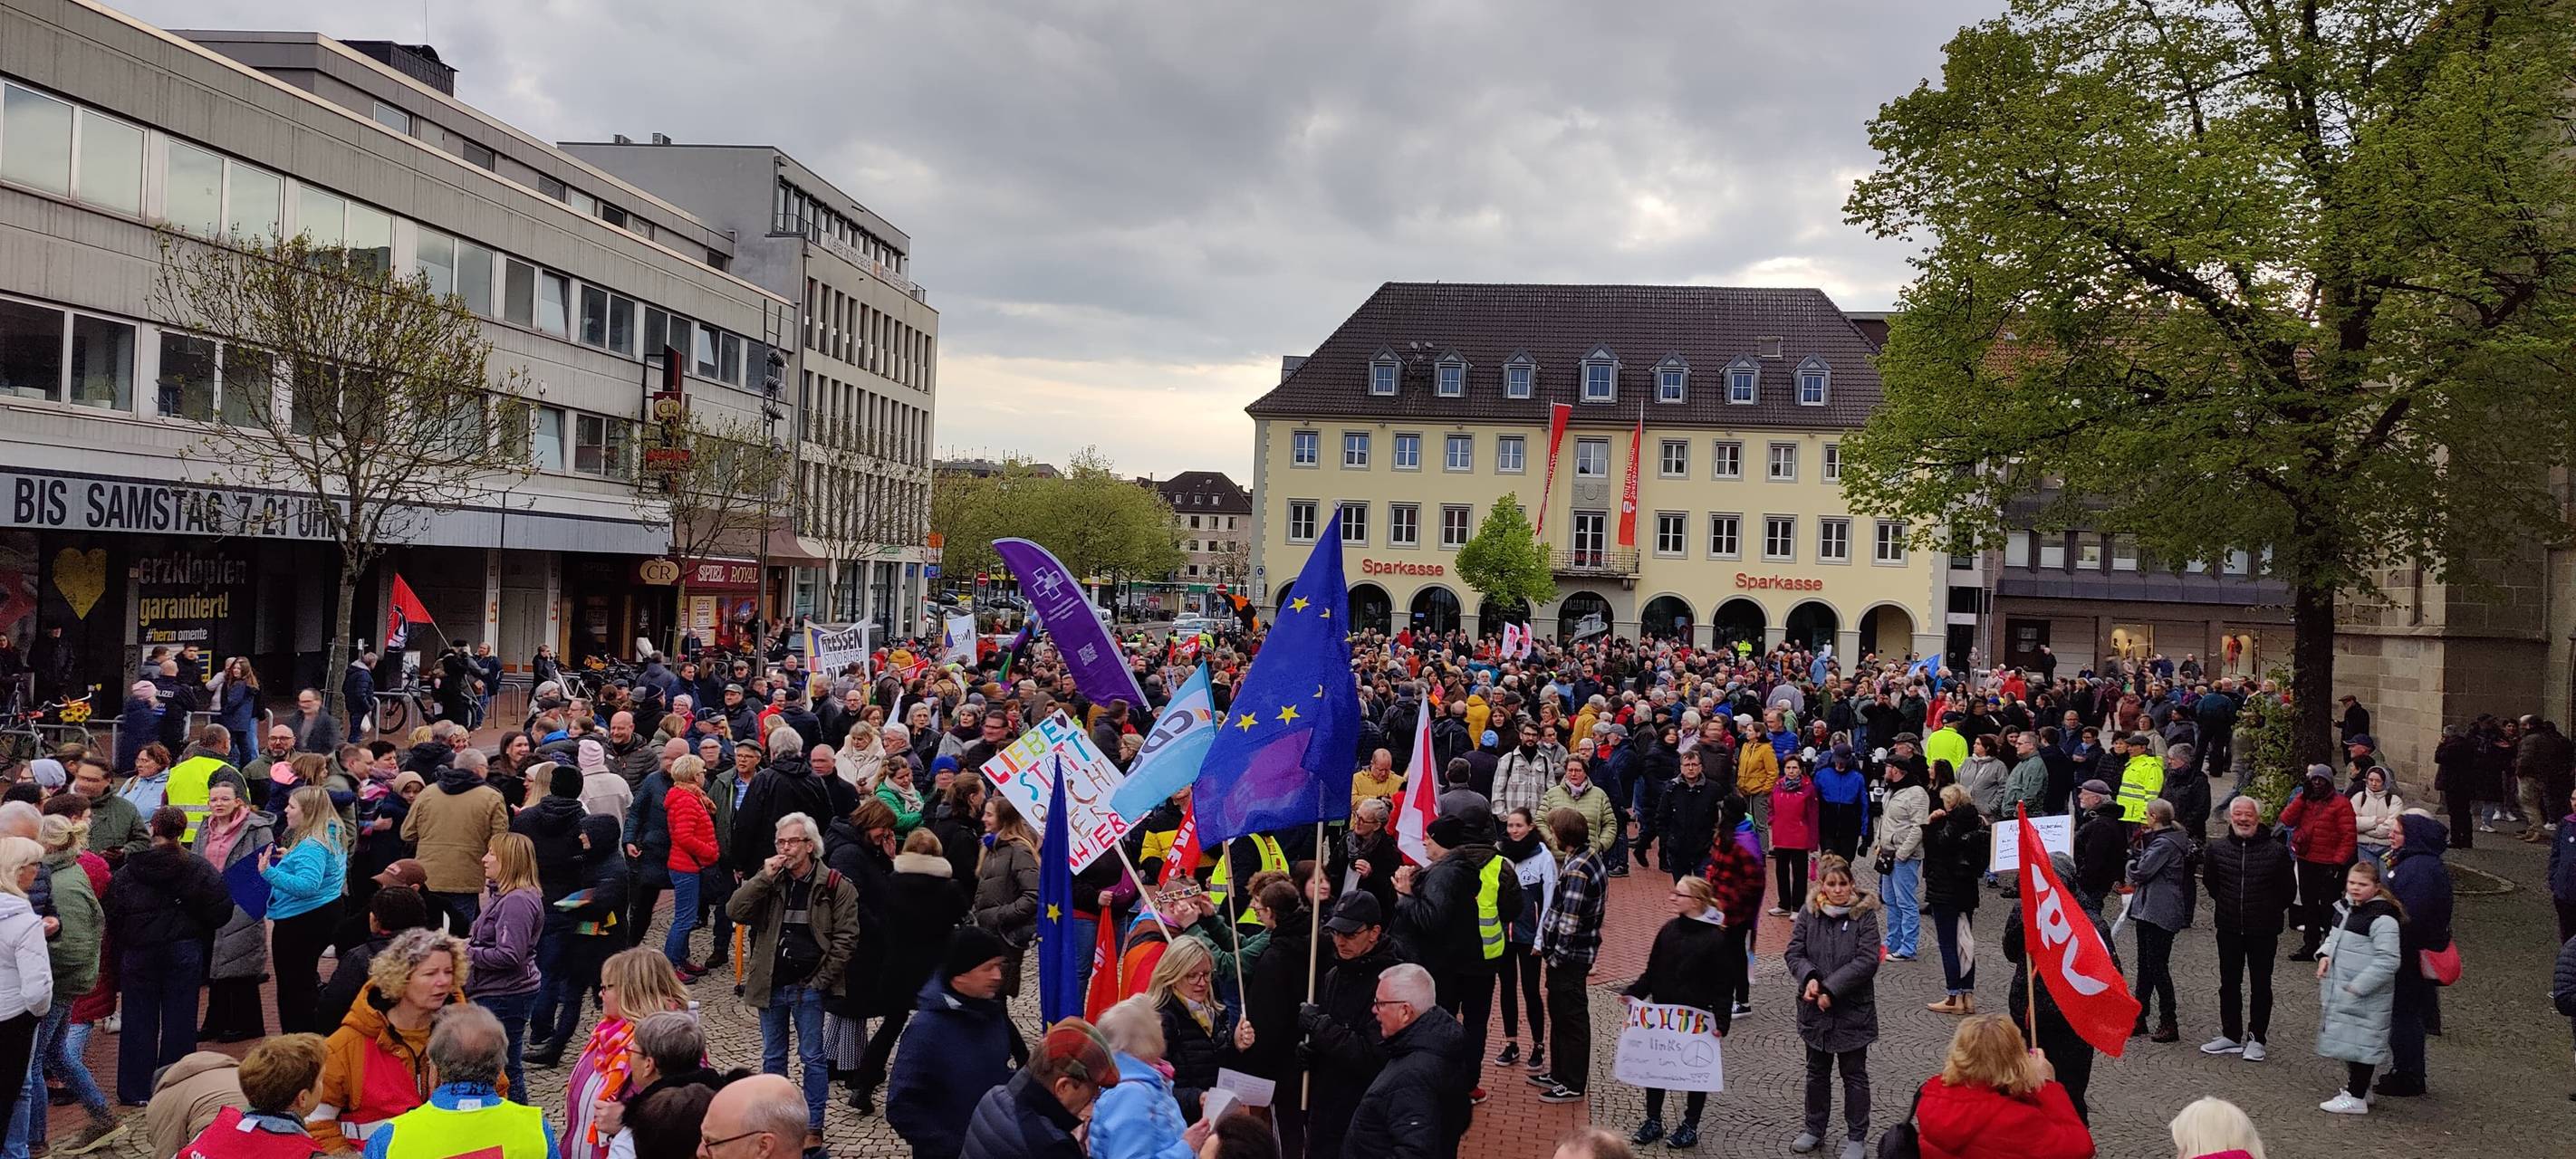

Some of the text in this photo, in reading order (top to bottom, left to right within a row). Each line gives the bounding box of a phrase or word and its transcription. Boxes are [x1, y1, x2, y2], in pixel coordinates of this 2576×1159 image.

[14, 477, 67, 525] BIS
[86, 482, 223, 534] SAMSTAG
[239, 495, 287, 535] 7-21
[647, 565, 671, 580] CR
[697, 565, 758, 584] SPIEL ROYAL
[1362, 559, 1444, 576] Sparkasse
[1735, 572, 1823, 591] Sparkasse
[139, 591, 228, 627] garantiert!
[985, 718, 1064, 784] LIEBE
[1019, 730, 1091, 800] STATT
[1073, 811, 1138, 863] HIEB
[1650, 1038, 1682, 1051] links
